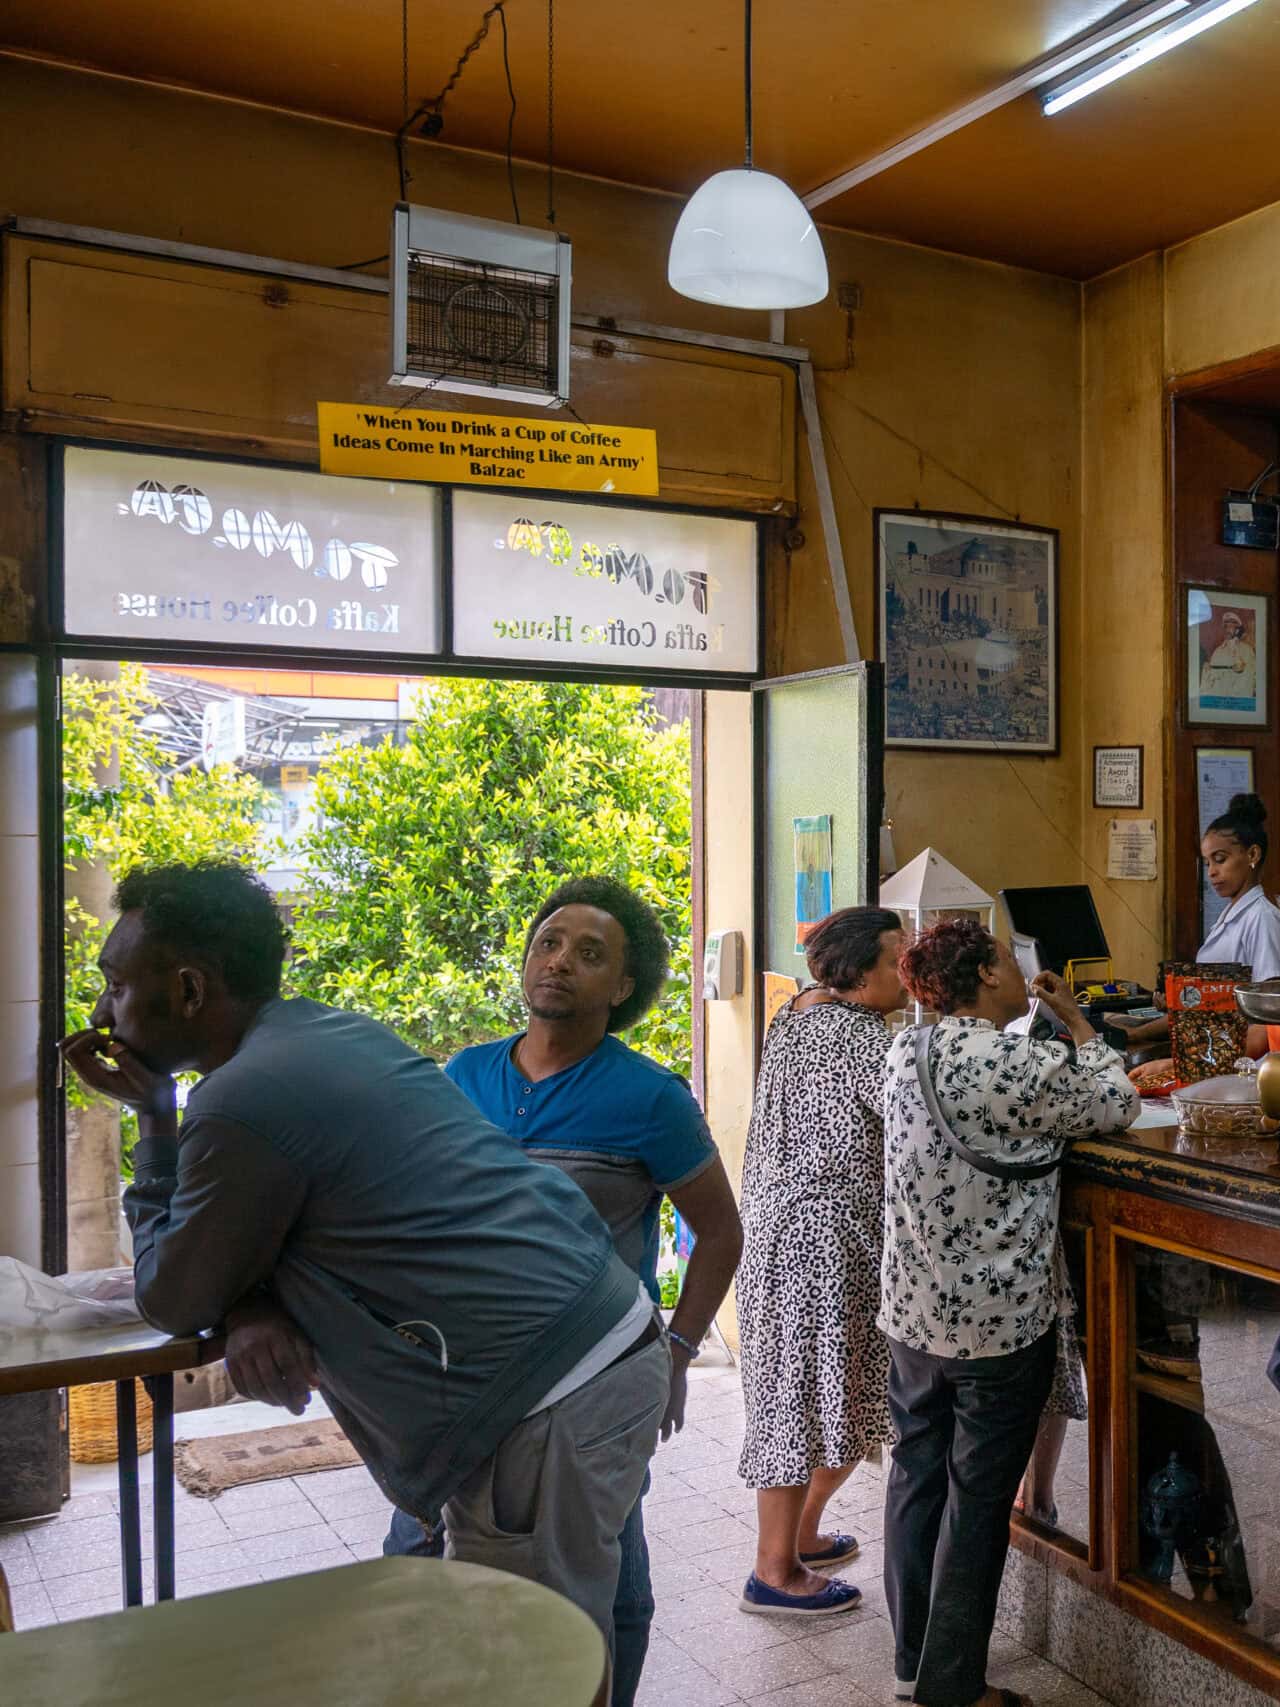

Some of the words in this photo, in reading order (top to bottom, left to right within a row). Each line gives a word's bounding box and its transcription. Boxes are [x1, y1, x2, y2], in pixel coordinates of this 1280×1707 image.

[416, 418, 447, 433] You
[451, 420, 496, 436] Drink
[501, 427, 510, 438] a
[515, 425, 546, 442] Cup
[551, 430, 566, 442] of
[570, 431, 622, 447] Coffee
[333, 433, 381, 450] Ideas
[386, 438, 434, 454] Come
[439, 441, 455, 455] In
[460, 443, 535, 463] Marching
[539, 448, 572, 464] Like
[576, 454, 595, 465] an
[470, 462, 525, 479] Balzac
[1108, 767, 1128, 777] Award
